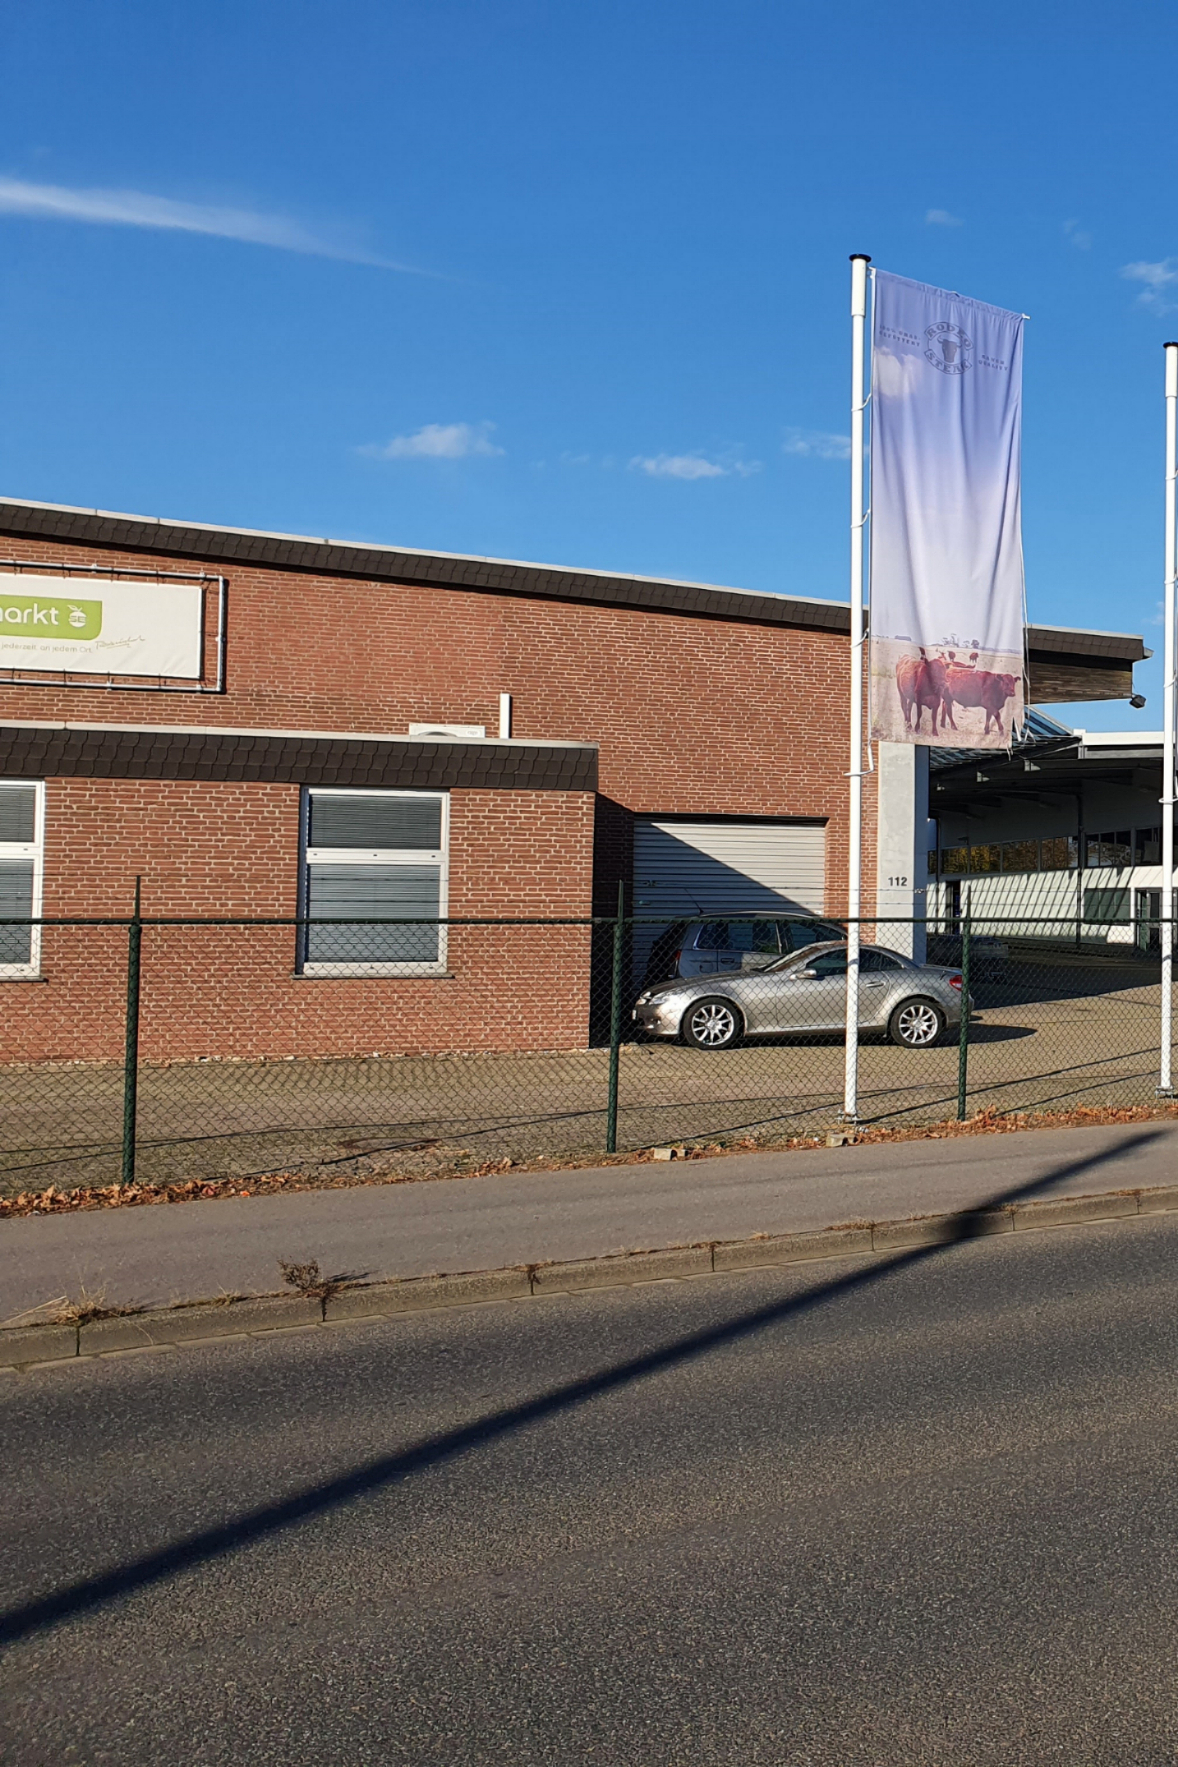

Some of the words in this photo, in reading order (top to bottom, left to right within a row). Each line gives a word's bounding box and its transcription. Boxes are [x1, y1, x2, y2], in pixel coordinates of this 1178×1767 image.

[926, 322, 973, 348] RODEO
[926, 352, 971, 373] STEAK
[0, 602, 59, 626] arkt
[52, 645, 78, 653] jedem
[888, 876, 908, 887] 112
